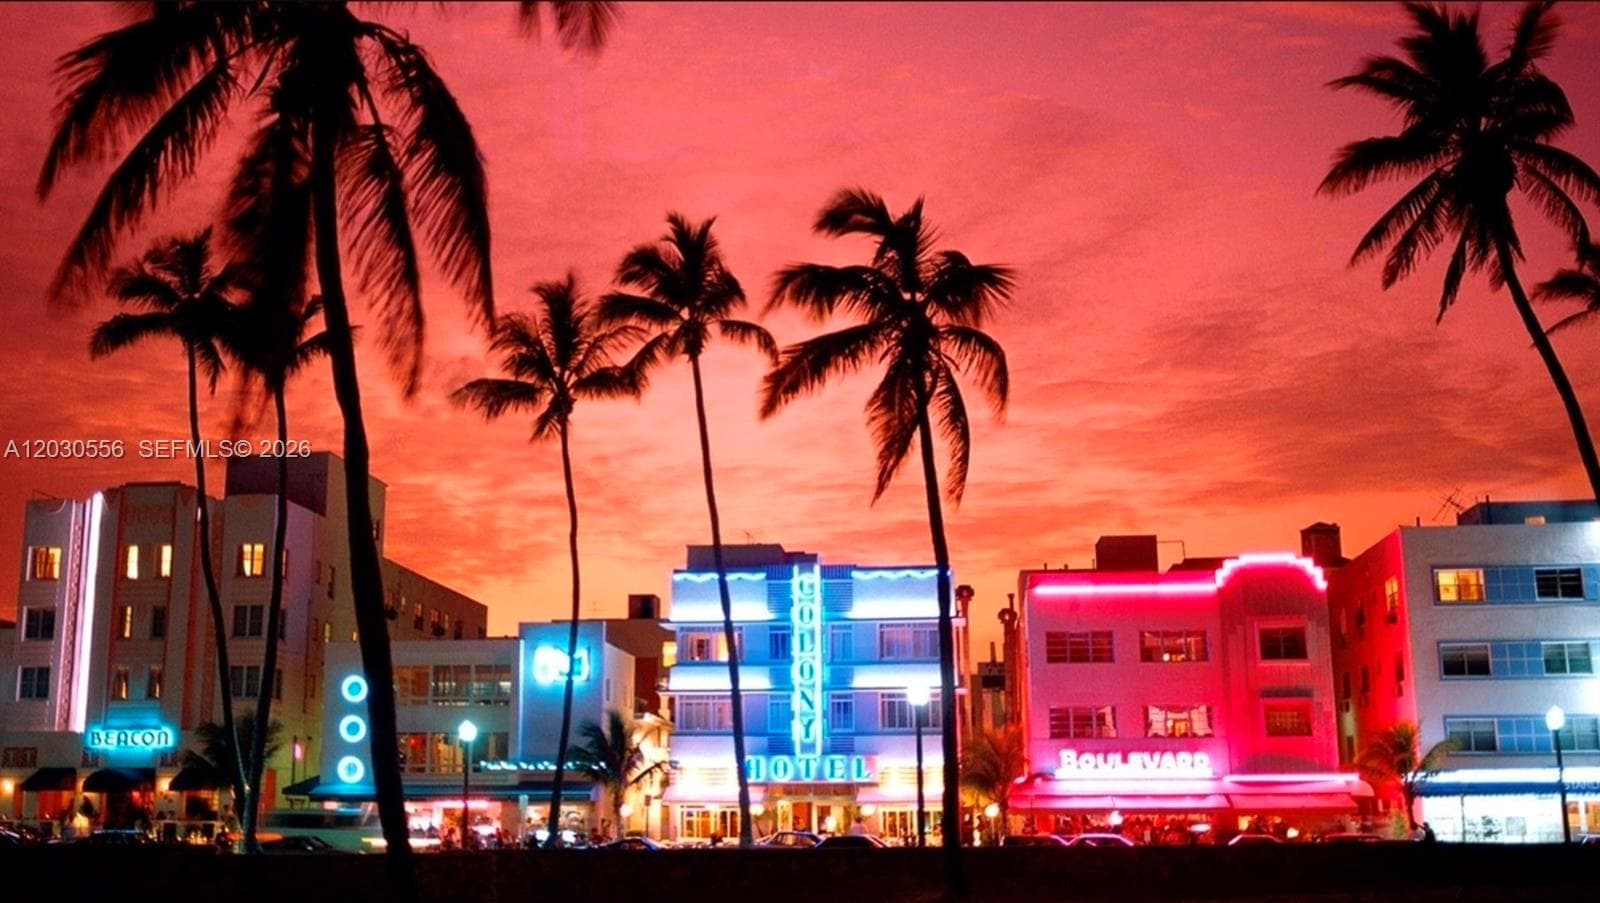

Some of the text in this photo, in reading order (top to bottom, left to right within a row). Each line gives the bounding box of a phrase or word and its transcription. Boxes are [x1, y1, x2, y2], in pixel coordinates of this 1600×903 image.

[796, 574, 817, 740] COLONY
[90, 730, 169, 746] BEACON
[745, 757, 873, 780] HOTEL
[1060, 749, 1211, 775] BOULEVARD
